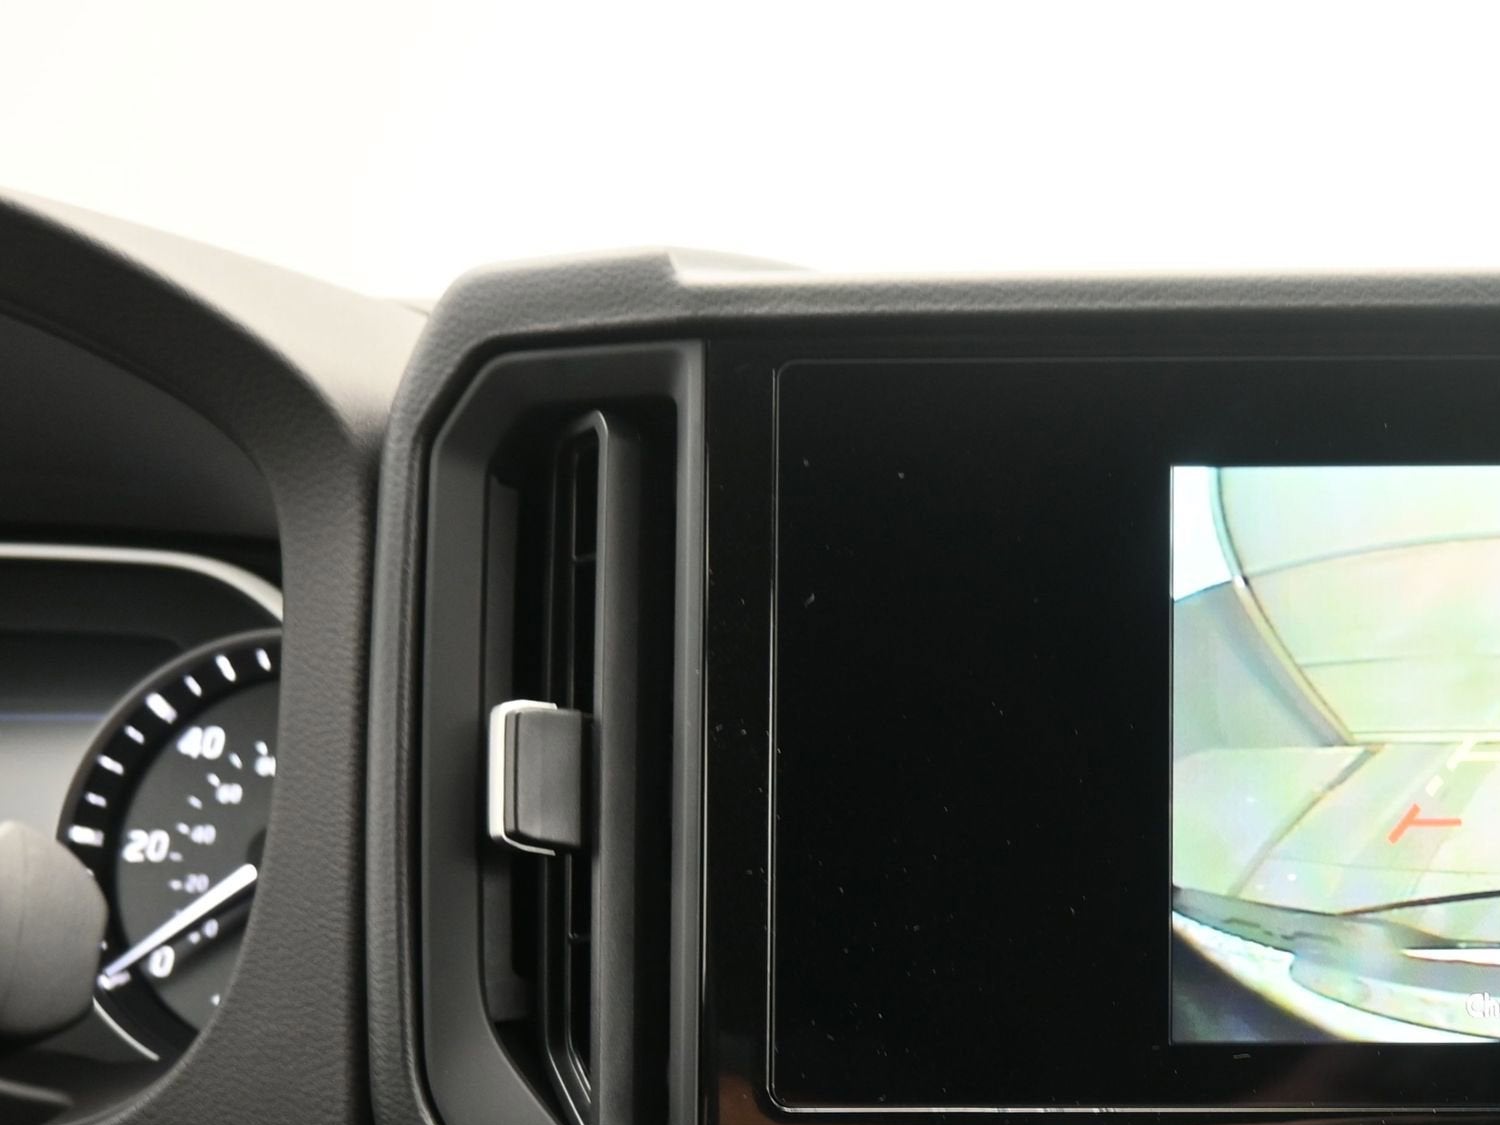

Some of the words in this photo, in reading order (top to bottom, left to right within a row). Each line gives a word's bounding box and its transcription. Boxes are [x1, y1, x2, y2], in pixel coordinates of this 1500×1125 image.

[178, 726, 225, 759] 40
[122, 829, 169, 863] 20
[149, 945, 175, 978] 0
